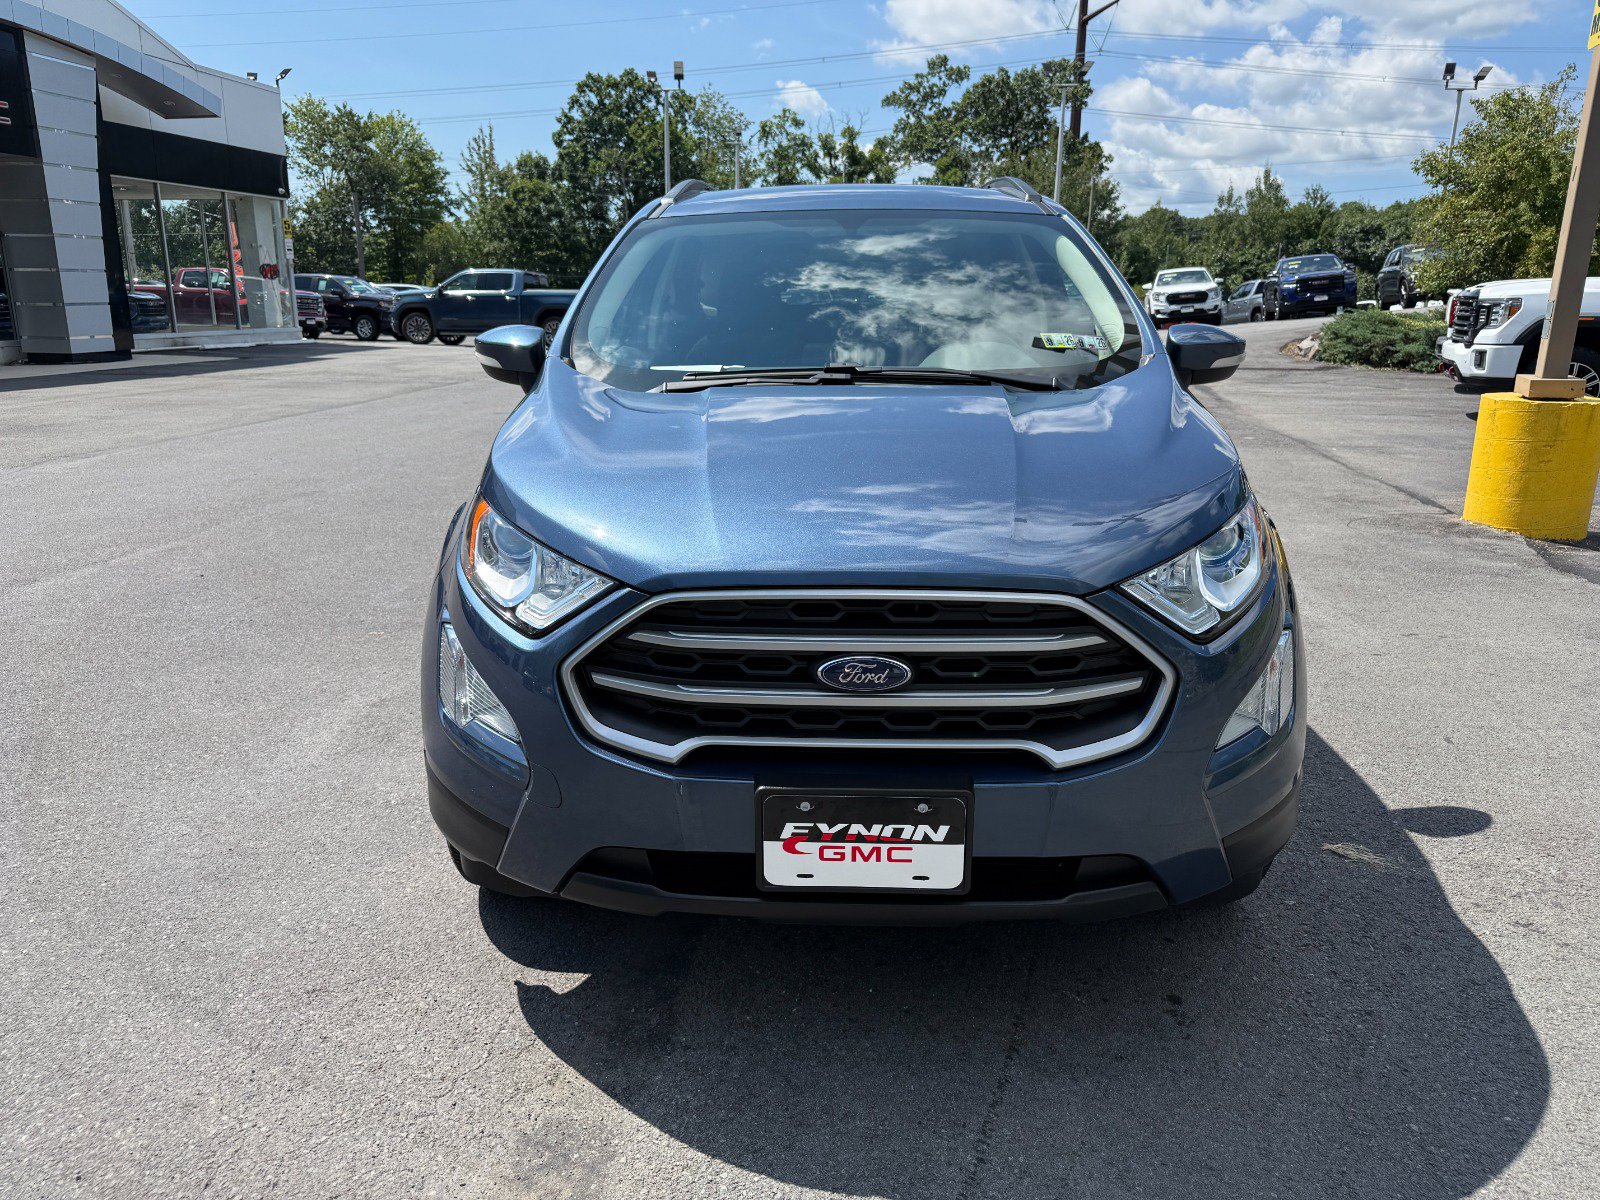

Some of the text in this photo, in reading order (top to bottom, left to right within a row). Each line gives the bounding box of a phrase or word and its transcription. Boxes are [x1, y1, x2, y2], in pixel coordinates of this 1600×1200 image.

[284, 220, 290, 230] 5
[838, 662, 890, 684] Ford
[818, 845, 913, 863] GMC
